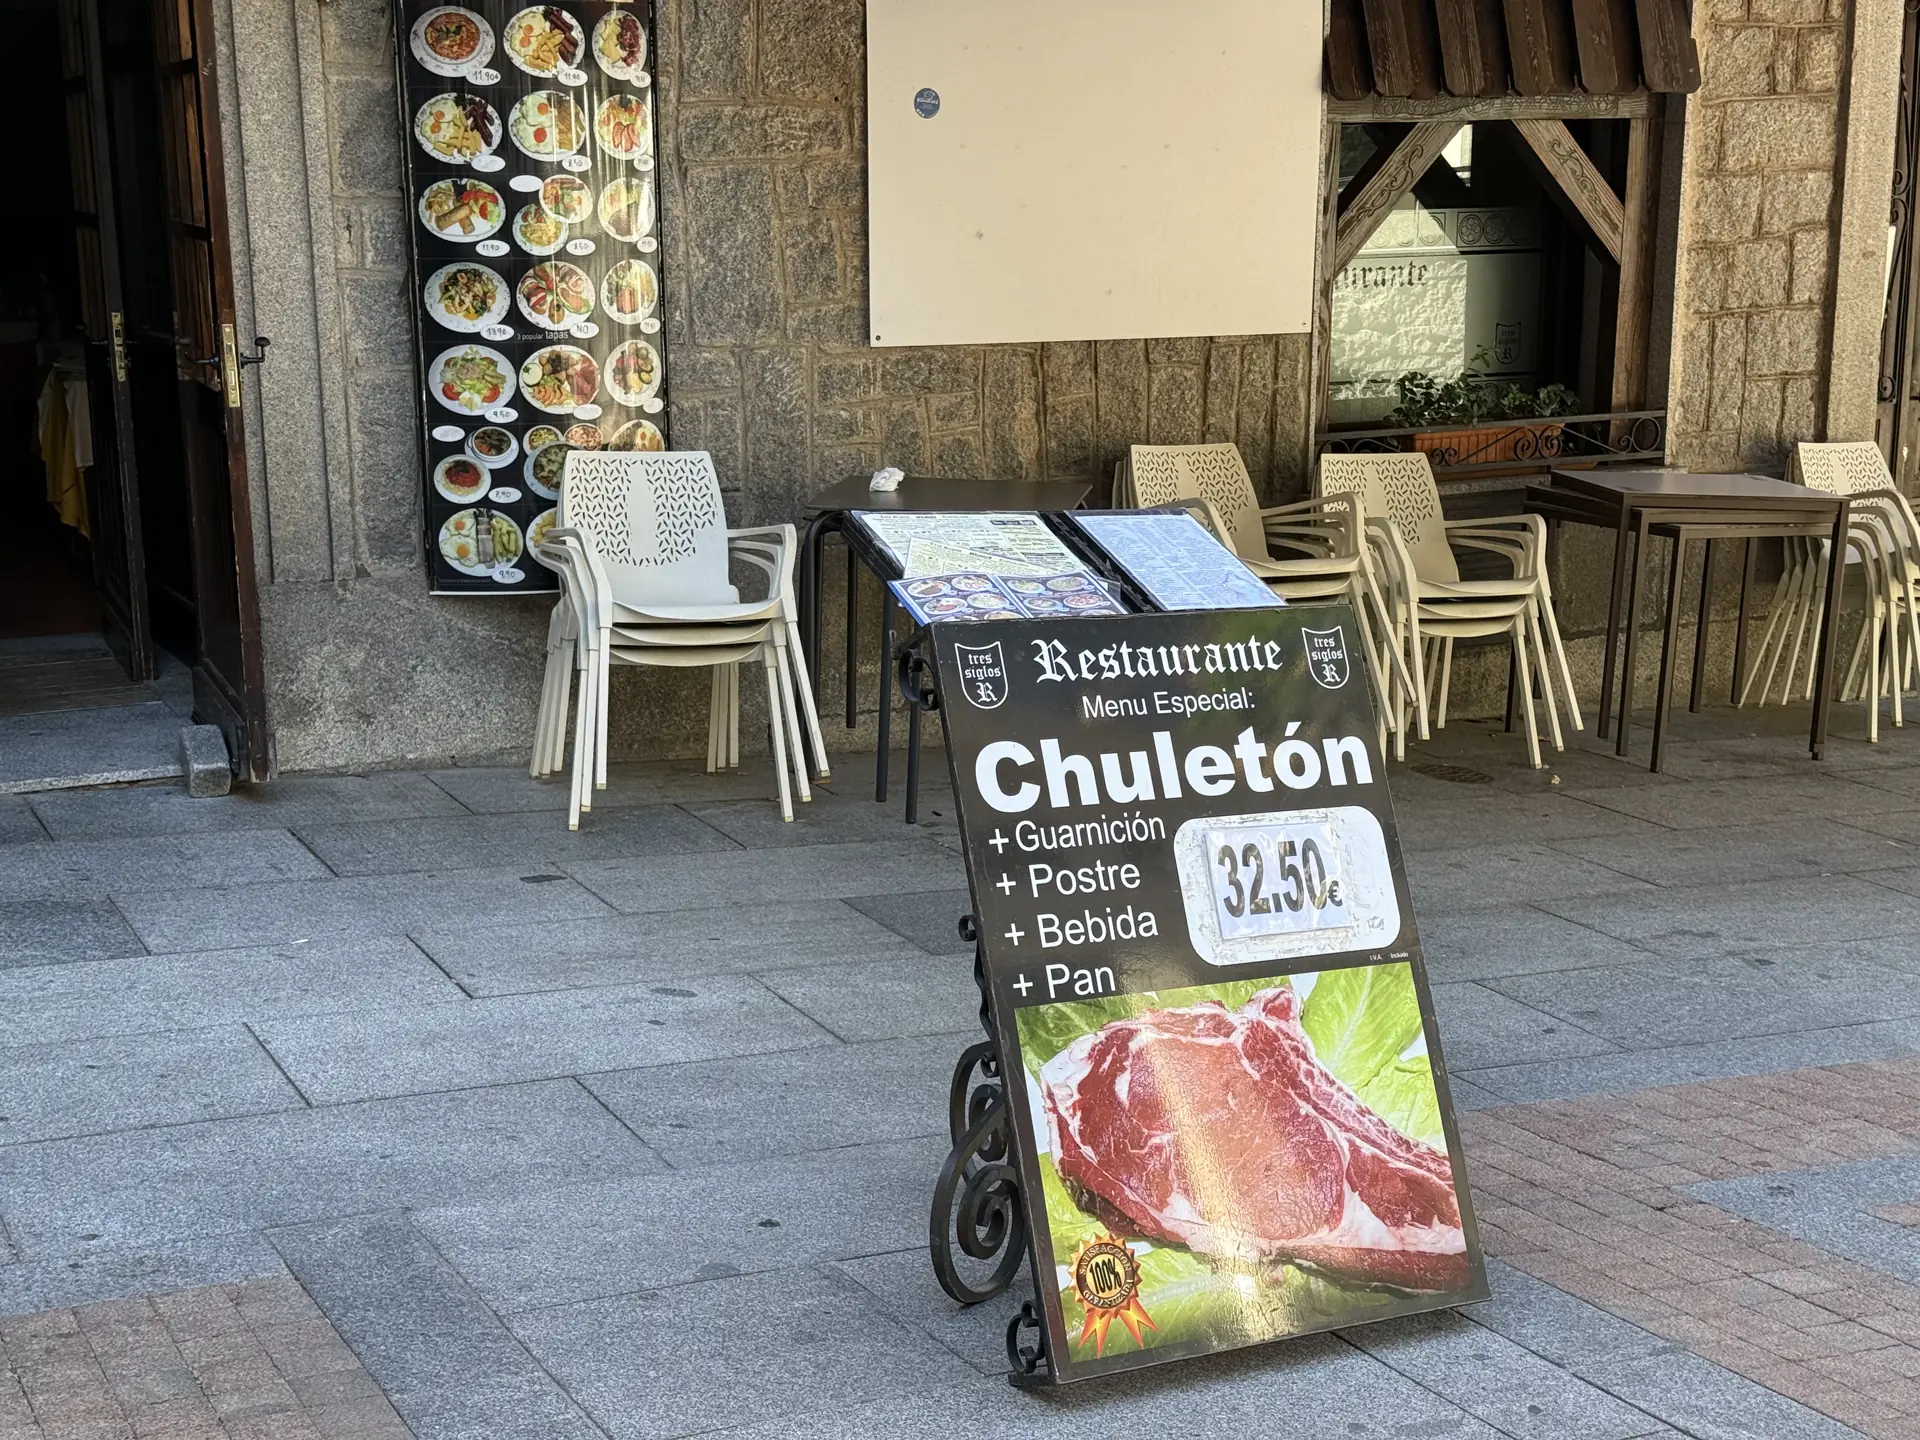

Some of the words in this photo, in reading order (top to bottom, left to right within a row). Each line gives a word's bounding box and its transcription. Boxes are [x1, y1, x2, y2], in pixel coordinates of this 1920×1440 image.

[1335, 260, 1428, 289] urante
[522, 333, 543, 341] popular
[545, 330, 569, 341] tapas
[1311, 648, 1343, 662] siglos
[1313, 637, 1335, 648] tres
[964, 665, 1001, 680] siglos
[968, 653, 993, 665] tres
[1030, 634, 1283, 684] Restaurante
[1321, 664, 1341, 682] R
[975, 682, 998, 702] R
[1082, 694, 1147, 718] Menu
[1153, 687, 1256, 718] Especial:
[974, 721, 1374, 813] Chuletón
[1015, 811, 1166, 851] Guarnición
[1028, 859, 1141, 898] Postre
[1217, 838, 1343, 918] 32.50€
[1036, 905, 1159, 948] Bebida
[1045, 963, 1116, 999] Pan
[1089, 1256, 1122, 1295] 100%
